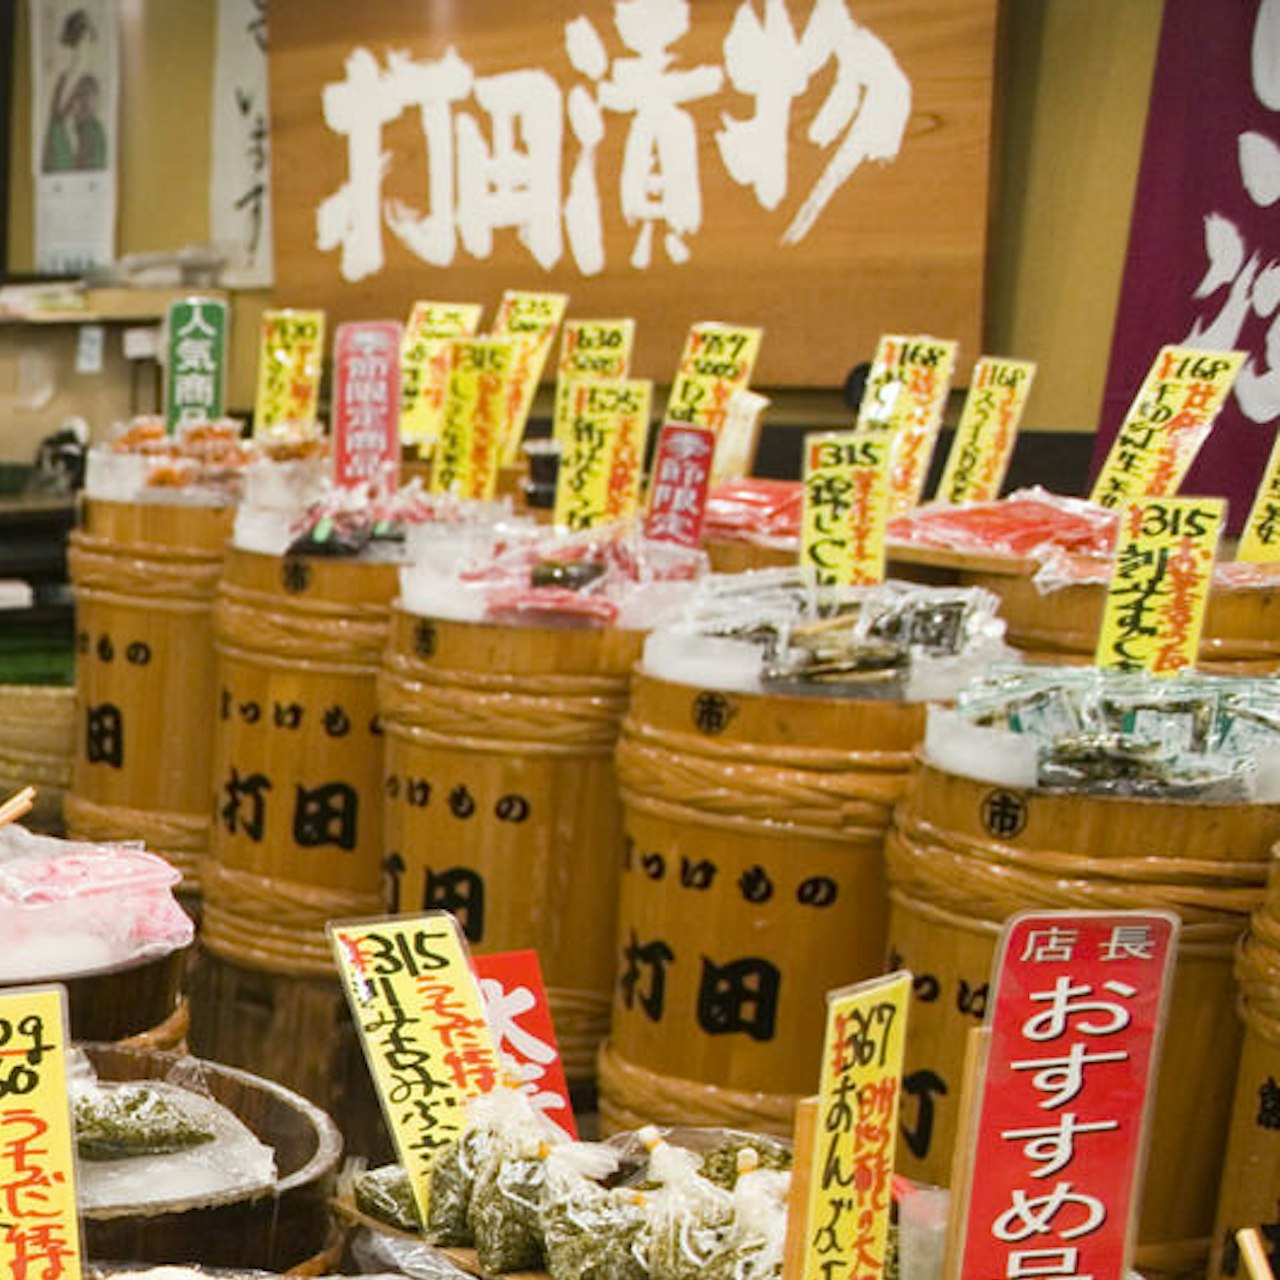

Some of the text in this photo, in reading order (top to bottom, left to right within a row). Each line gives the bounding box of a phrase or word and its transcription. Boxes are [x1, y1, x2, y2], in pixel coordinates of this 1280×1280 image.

[316, 0, 912, 282] 打田漬物
[979, 365, 1026, 388] ¥168
[1160, 354, 1229, 382] ¥168
[810, 443, 880, 470] ¥315
[1128, 504, 1217, 538] ¥315
[221, 768, 359, 852] 打田
[338, 931, 451, 978] ¥315
[620, 928, 782, 1042] 打田
[833, 1002, 896, 1075] ¥367
